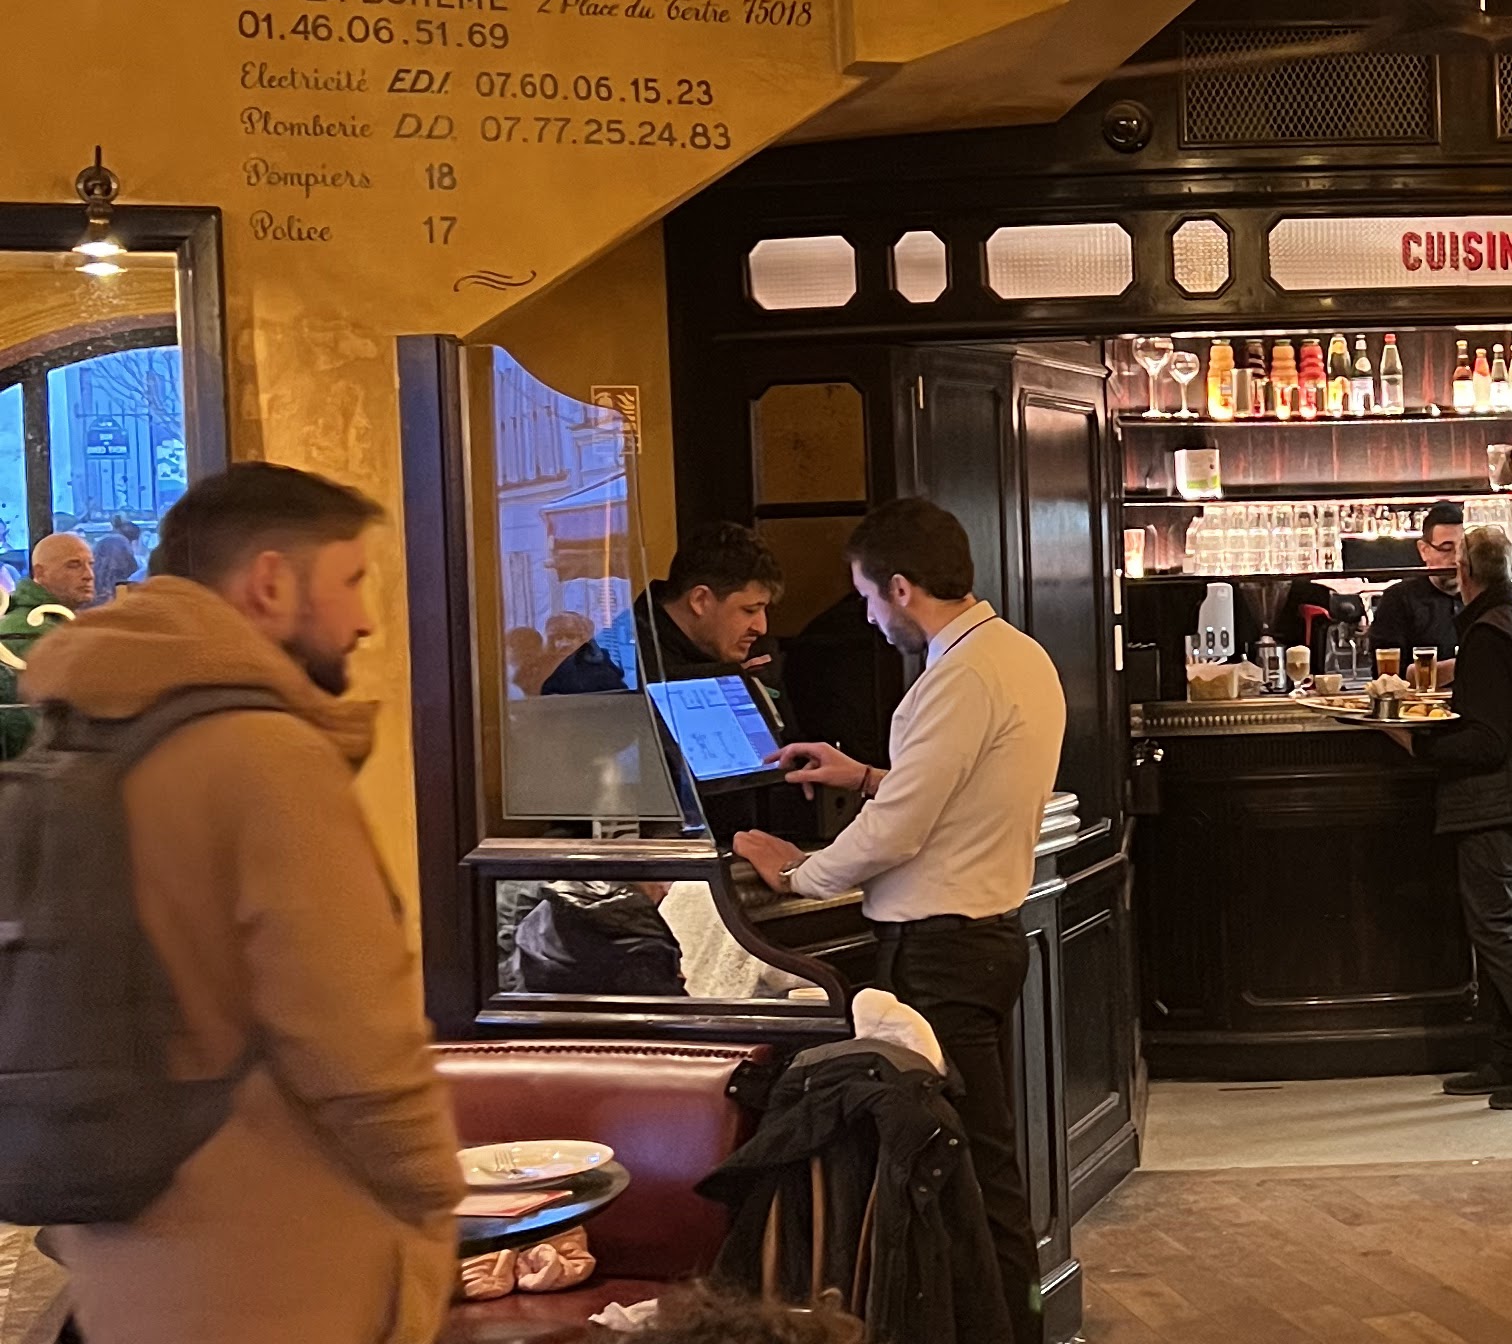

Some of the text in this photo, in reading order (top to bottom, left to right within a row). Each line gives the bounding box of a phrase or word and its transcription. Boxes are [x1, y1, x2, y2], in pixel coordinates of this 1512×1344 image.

[237, 10, 510, 50] 01.46.06.51.69
[240, 60, 369, 93] Electricité
[475, 71, 714, 106] 07.60.06.15.23
[240, 106, 373, 138] Plomberie
[480, 116, 732, 151] 07.77.25.24.83
[242, 157, 457, 199] Pompiers 18
[250, 209, 458, 245] Police 17
